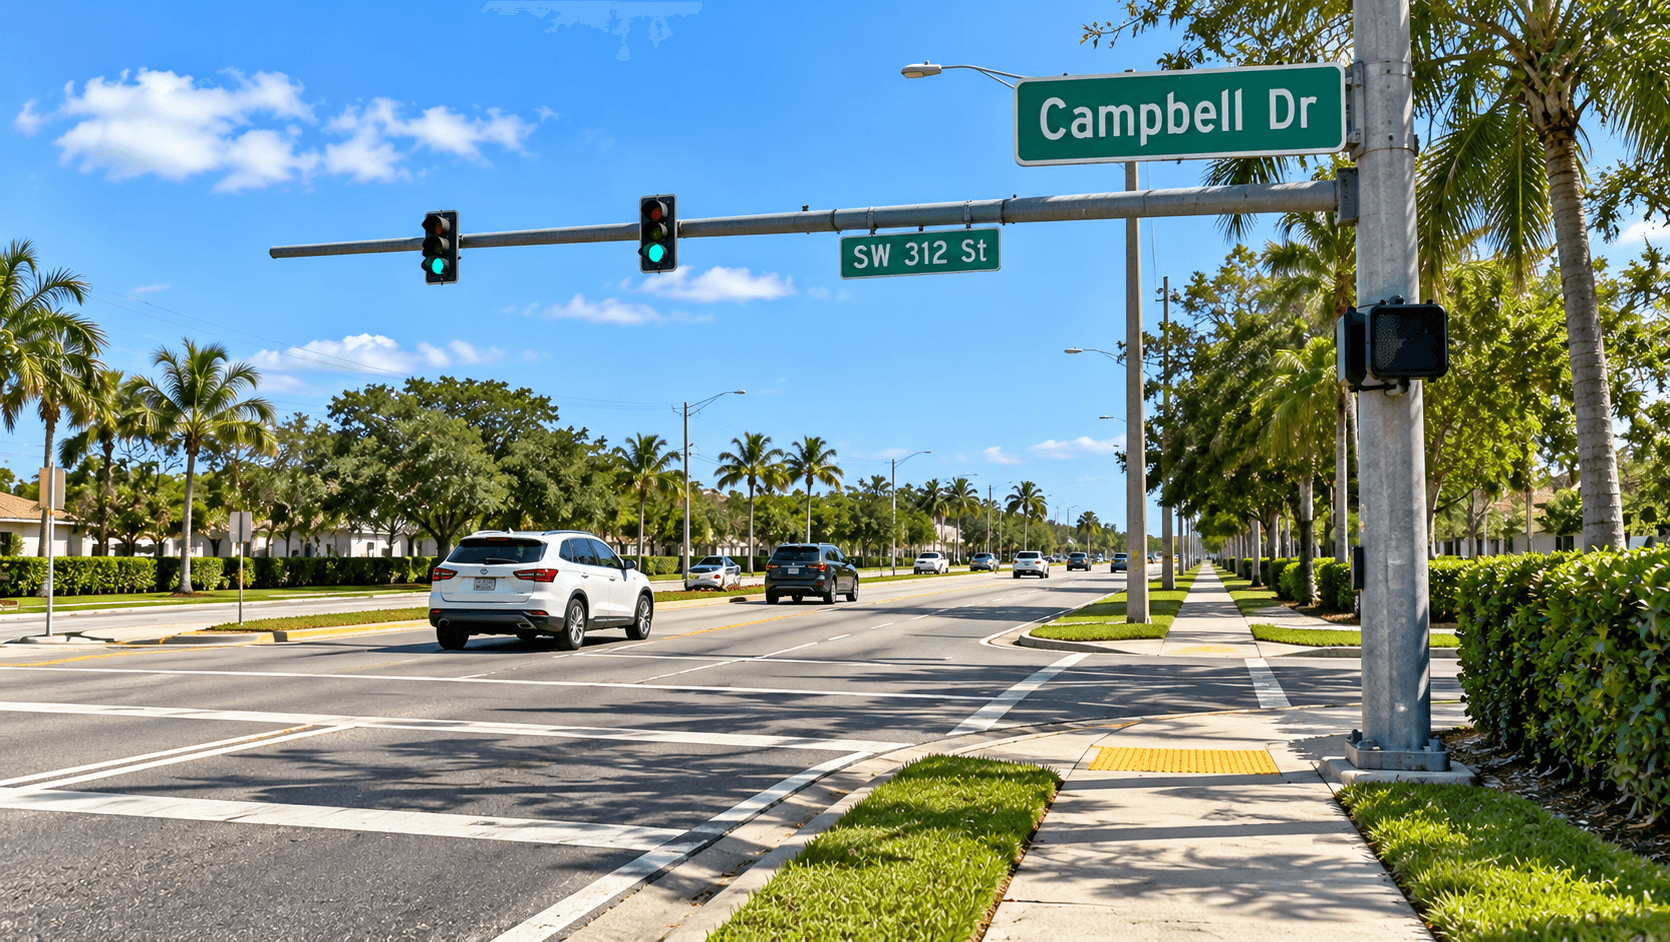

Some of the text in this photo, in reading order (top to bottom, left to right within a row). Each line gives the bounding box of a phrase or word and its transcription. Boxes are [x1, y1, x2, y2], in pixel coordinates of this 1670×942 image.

[1039, 88, 1318, 147] Campbell Dr
[853, 238, 988, 269] SW 312 St
